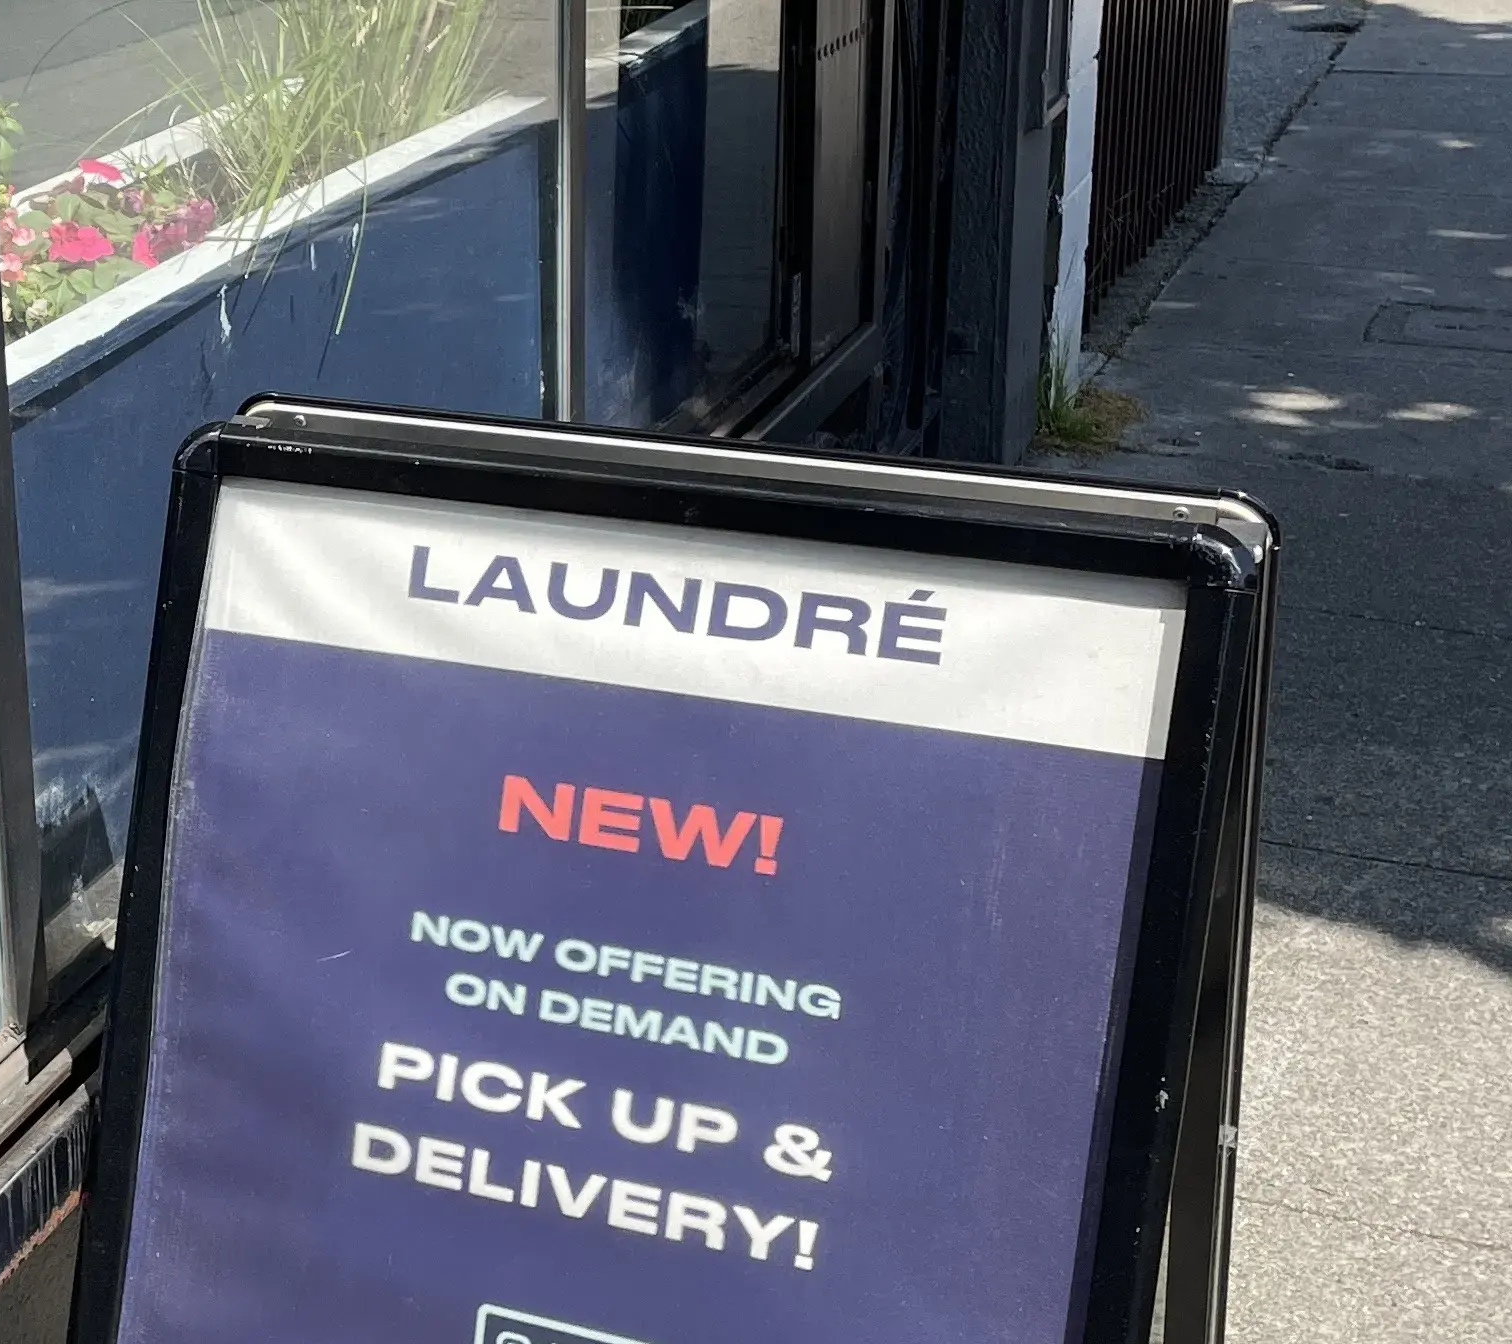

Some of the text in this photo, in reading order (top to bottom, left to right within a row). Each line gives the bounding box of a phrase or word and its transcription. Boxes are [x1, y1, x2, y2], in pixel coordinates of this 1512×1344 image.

[407, 544, 948, 666] LAUNDRÉ
[497, 774, 785, 875] NEW!
[408, 910, 843, 1021] NOW OFFERING
[445, 972, 790, 1066] ON DEMAND
[375, 1040, 835, 1183] PICK UP &
[350, 1121, 821, 1271] DELIVERY!
